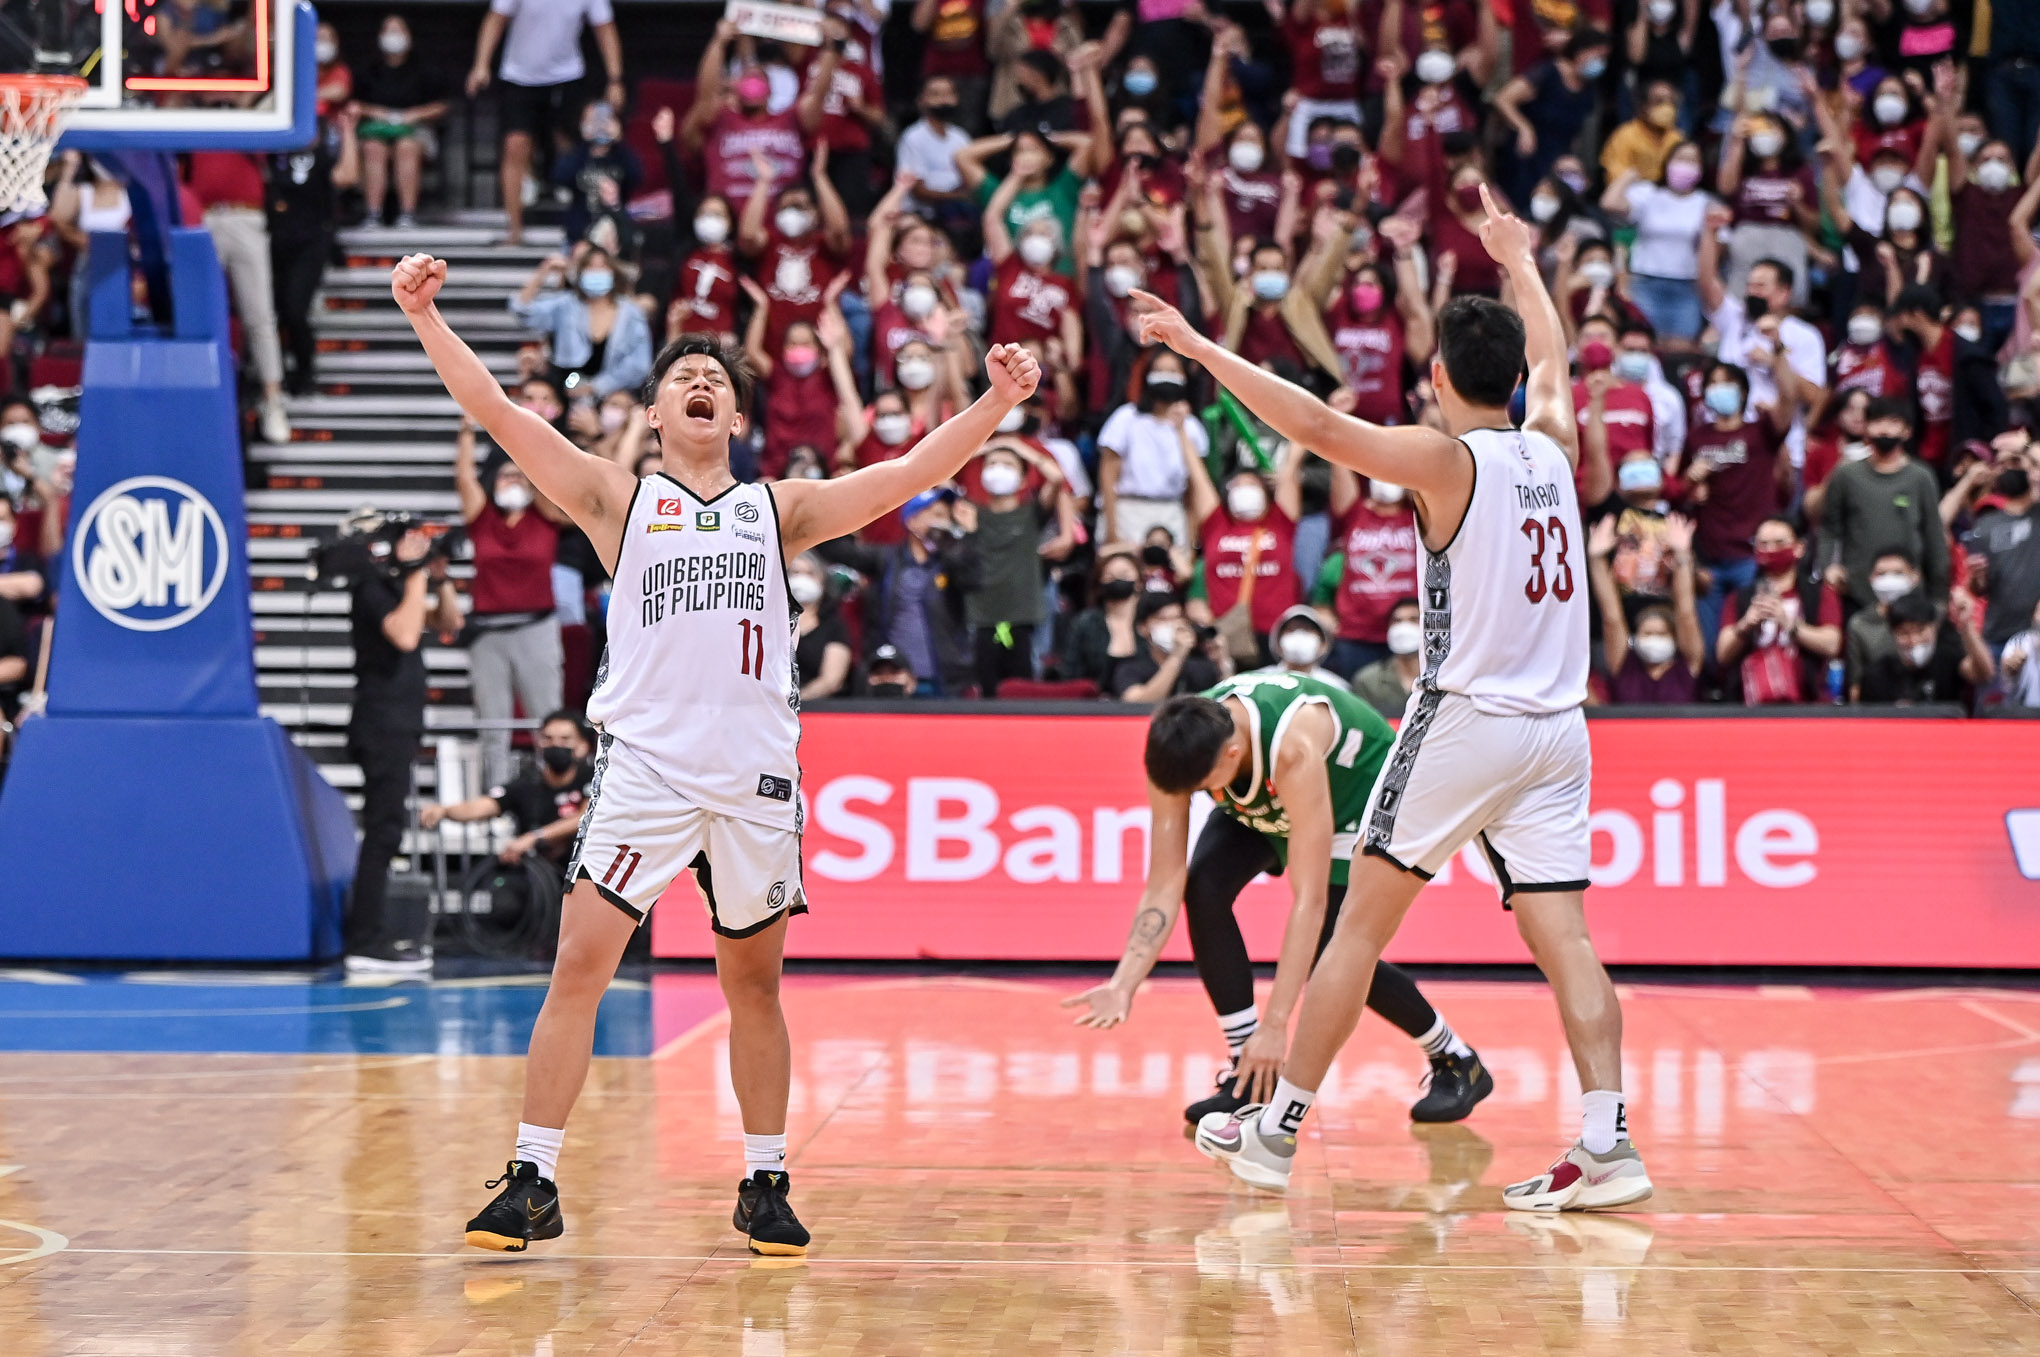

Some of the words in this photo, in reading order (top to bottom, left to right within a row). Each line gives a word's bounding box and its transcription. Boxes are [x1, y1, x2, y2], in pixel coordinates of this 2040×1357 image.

[88, 494, 204, 610] SM
[642, 552, 766, 597] UNIBERSIDAD
[1520, 516, 1574, 605] 33
[642, 592, 665, 628] NG
[671, 581, 765, 615] PILIPINAS
[737, 618, 764, 681] 11
[798, 774, 1269, 885] SBan
[601, 844, 643, 894] 11
